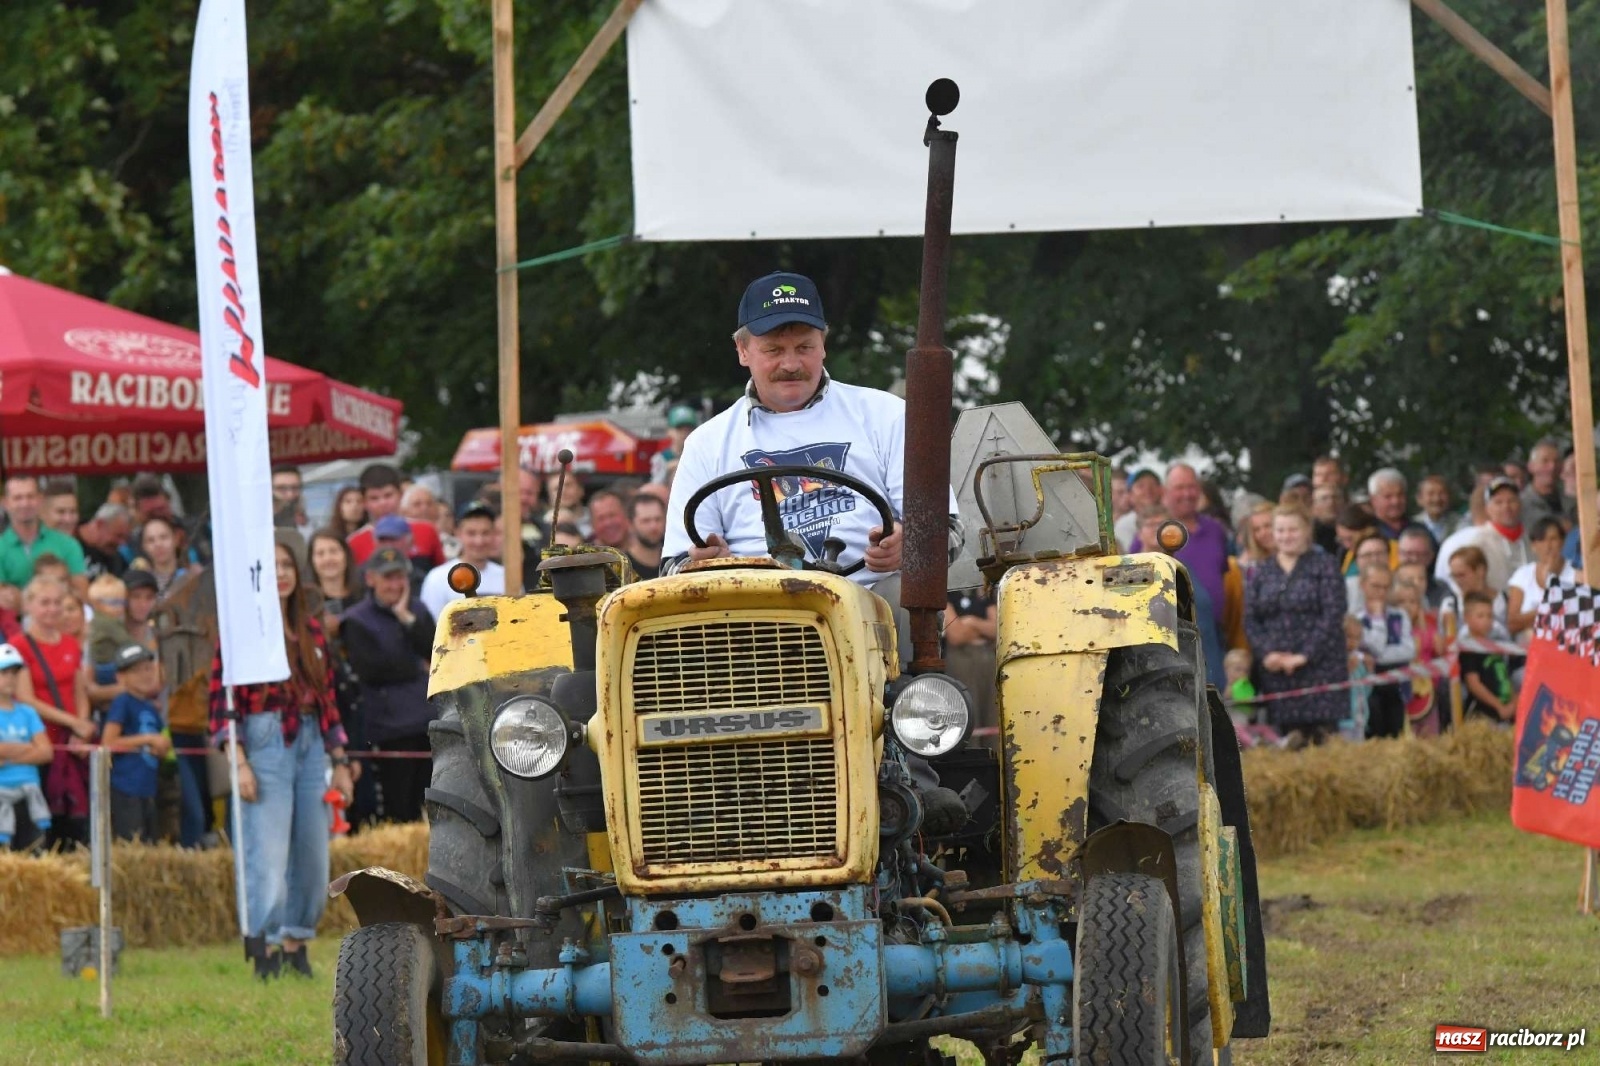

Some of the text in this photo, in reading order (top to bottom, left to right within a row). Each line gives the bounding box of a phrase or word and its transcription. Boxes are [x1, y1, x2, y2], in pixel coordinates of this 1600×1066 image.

[763, 297, 810, 308] EL-TRAKTOR
[783, 496, 855, 531] ACING
[655, 710, 811, 738] URSUS
